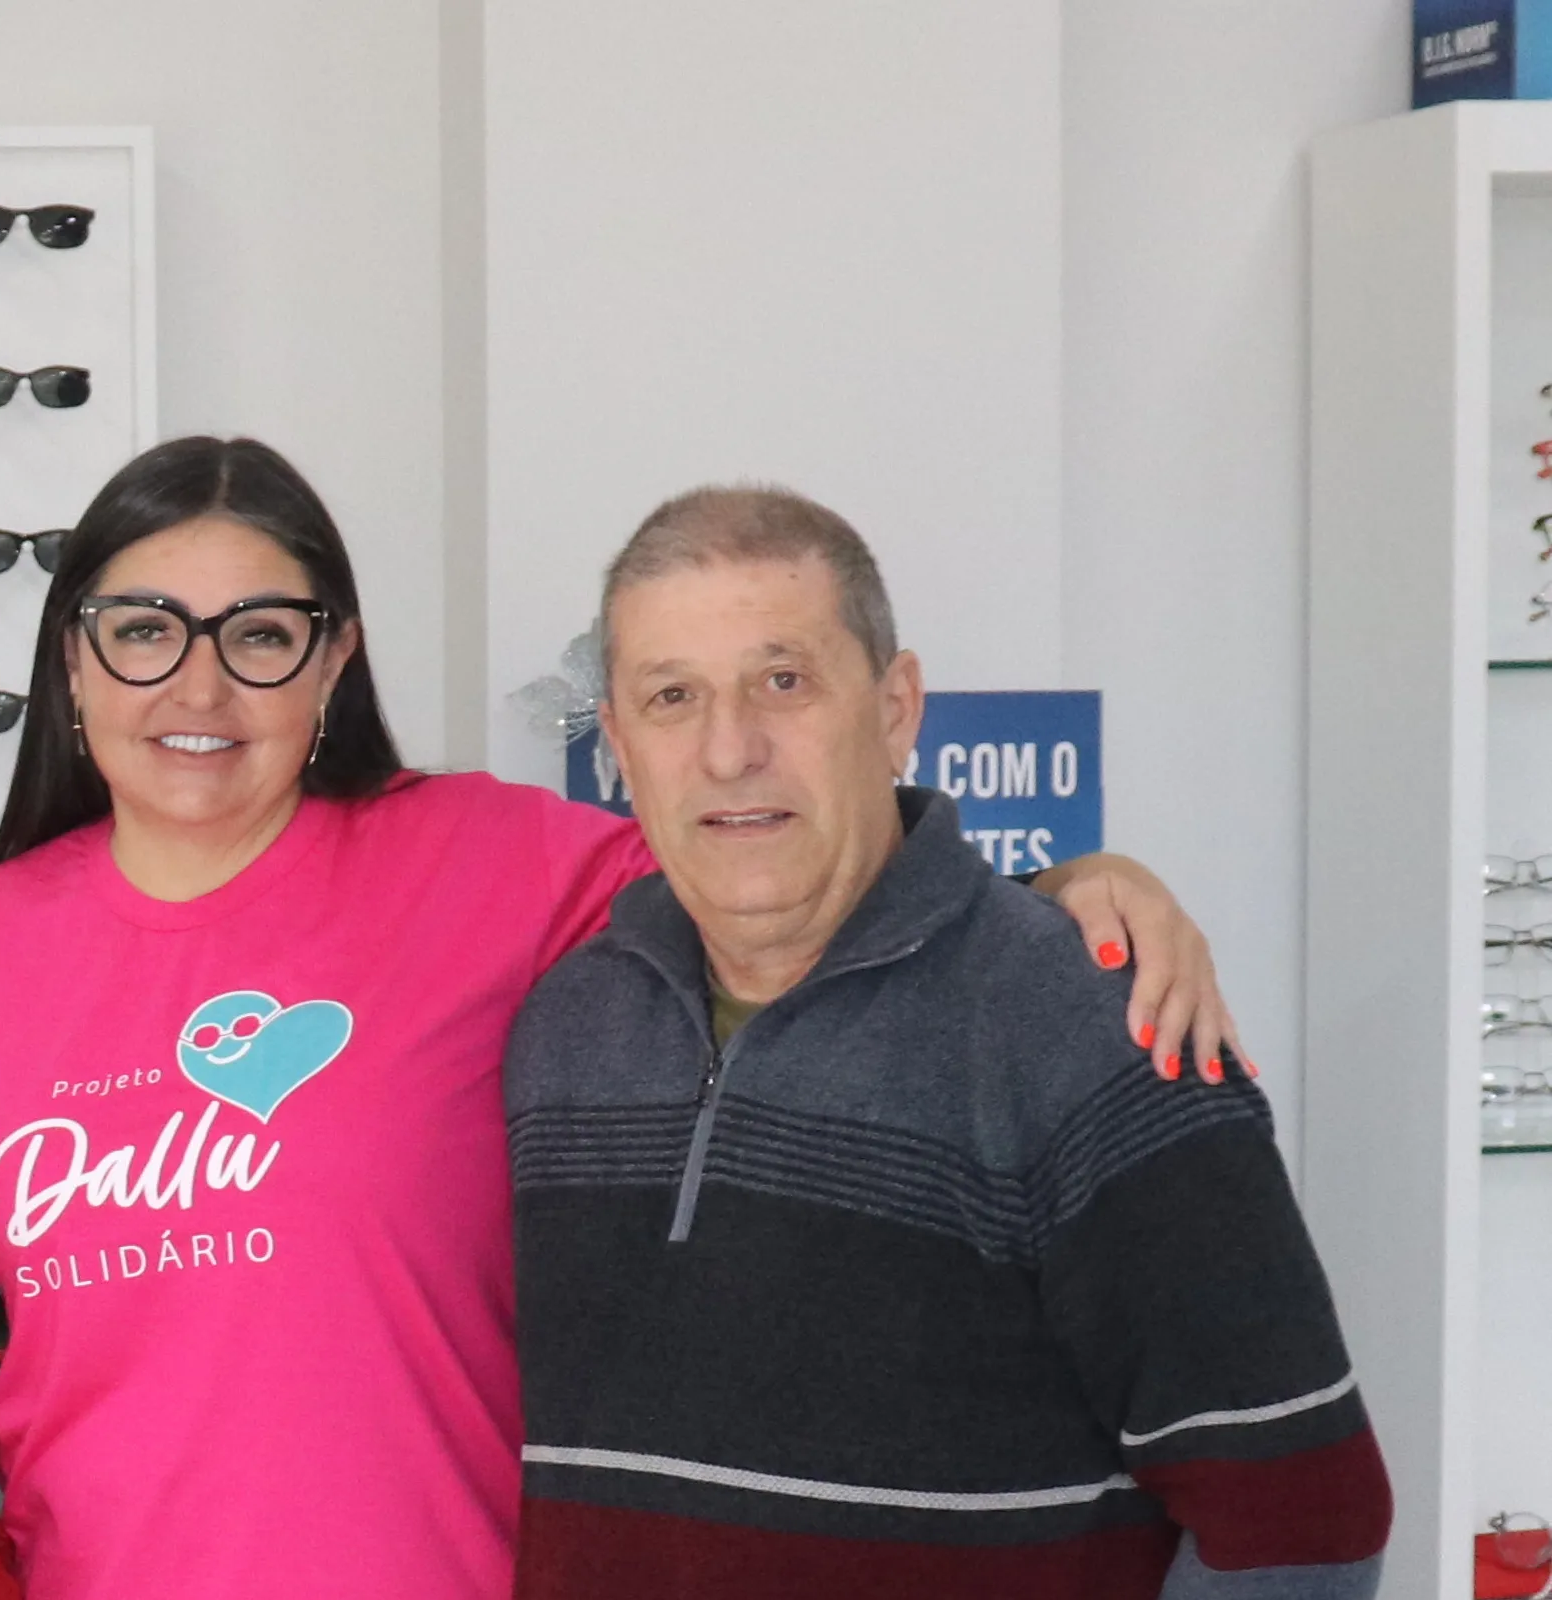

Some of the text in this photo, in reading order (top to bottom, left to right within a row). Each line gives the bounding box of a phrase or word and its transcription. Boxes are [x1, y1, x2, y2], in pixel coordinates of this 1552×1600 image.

[937, 742, 1037, 800] COM
[1051, 740, 1079, 798] O
[51, 1067, 163, 1099] Projeto
[15, 1227, 275, 1298] SOLIDÁRIO
